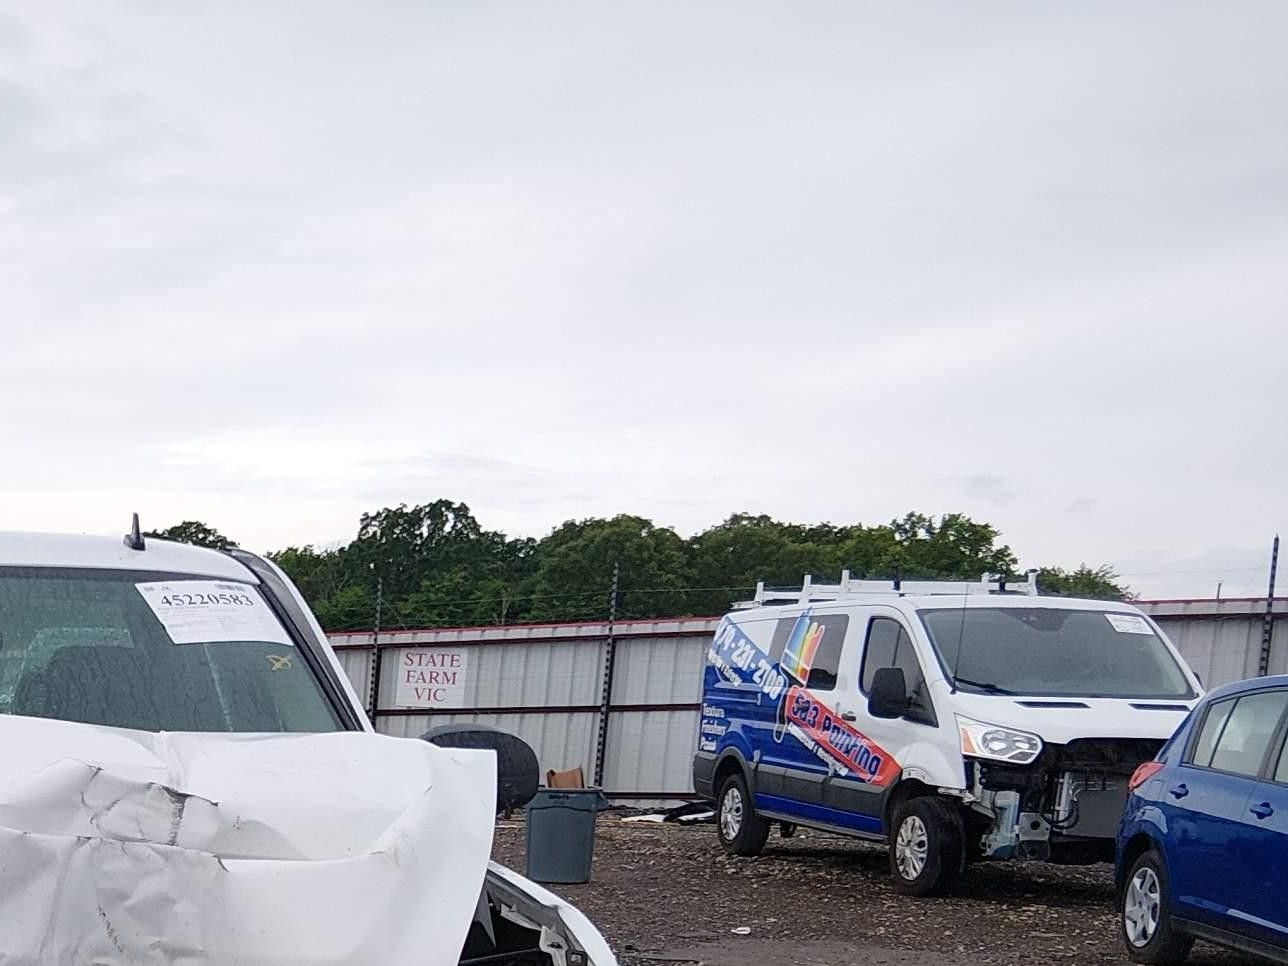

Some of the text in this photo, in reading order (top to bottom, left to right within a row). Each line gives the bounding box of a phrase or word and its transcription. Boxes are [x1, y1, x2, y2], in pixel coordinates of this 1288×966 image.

[161, 593, 254, 607] 45220583
[404, 652, 461, 668] STATE
[405, 670, 458, 685] FARM
[414, 687, 447, 702] VIC
[821, 715, 882, 784] Painting
